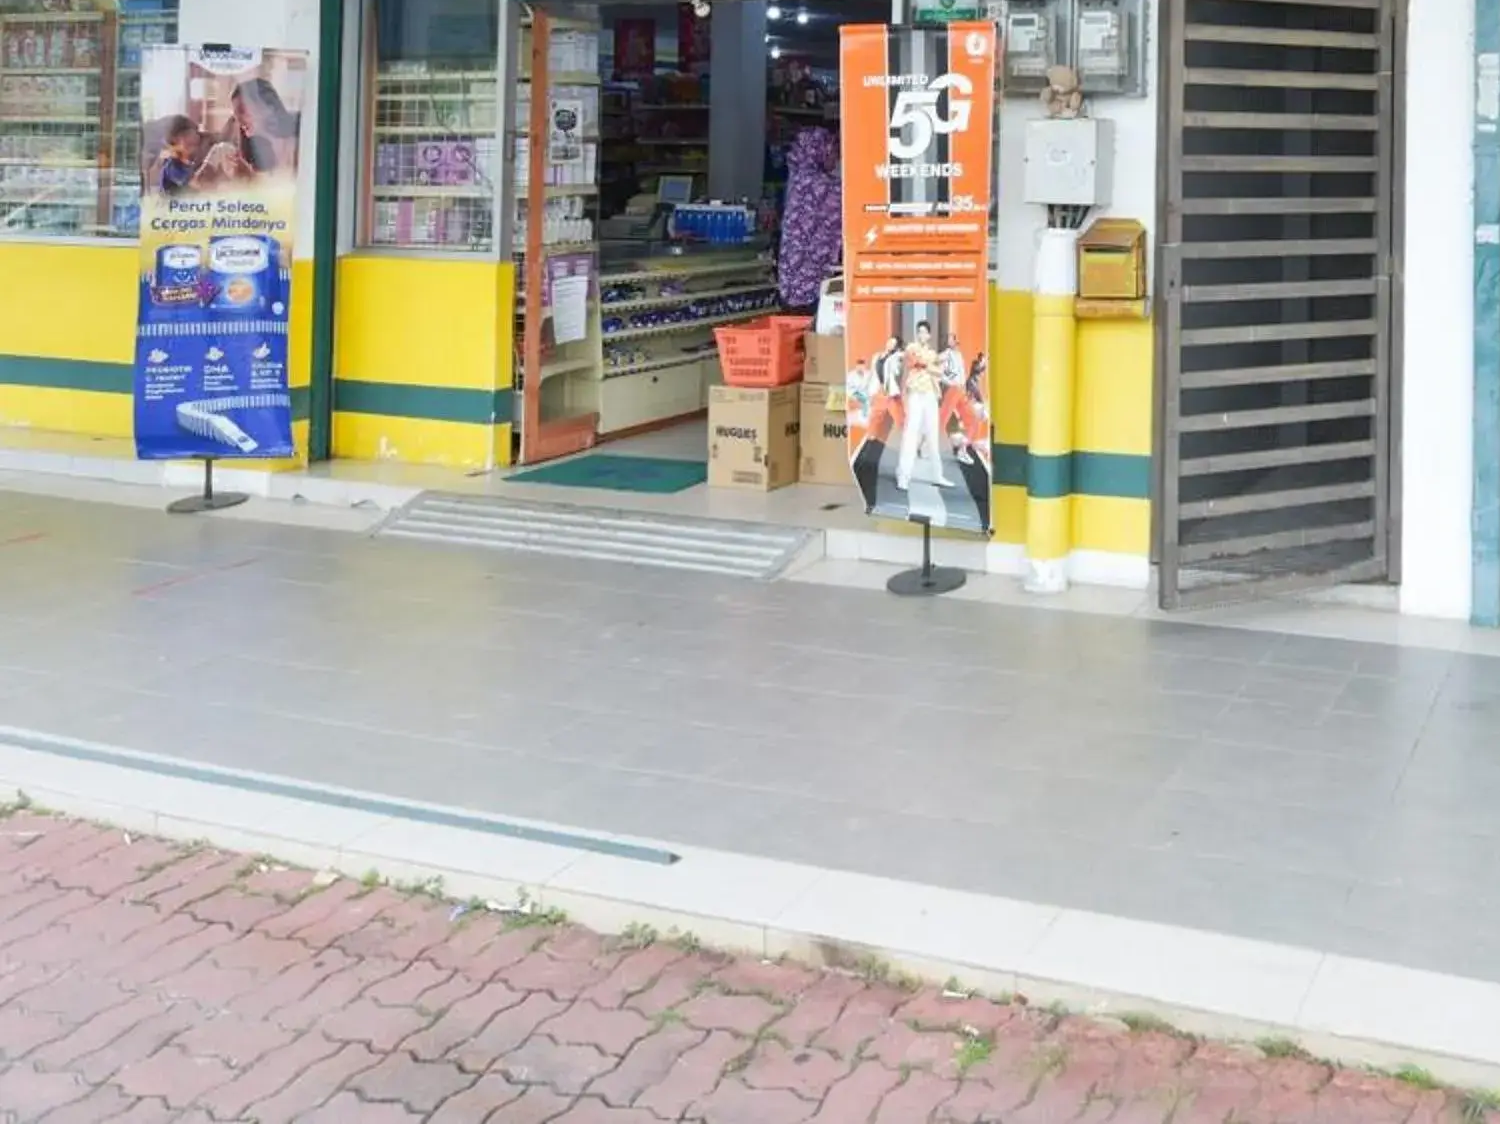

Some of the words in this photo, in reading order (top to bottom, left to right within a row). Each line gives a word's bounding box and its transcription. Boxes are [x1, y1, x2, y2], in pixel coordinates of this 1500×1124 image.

[888, 73, 974, 158] 5G
[874, 163, 964, 179] WEEKENDS
[169, 199, 212, 213] Perut
[151, 217, 207, 232] Cergas
[715, 427, 758, 440] HUGGIES
